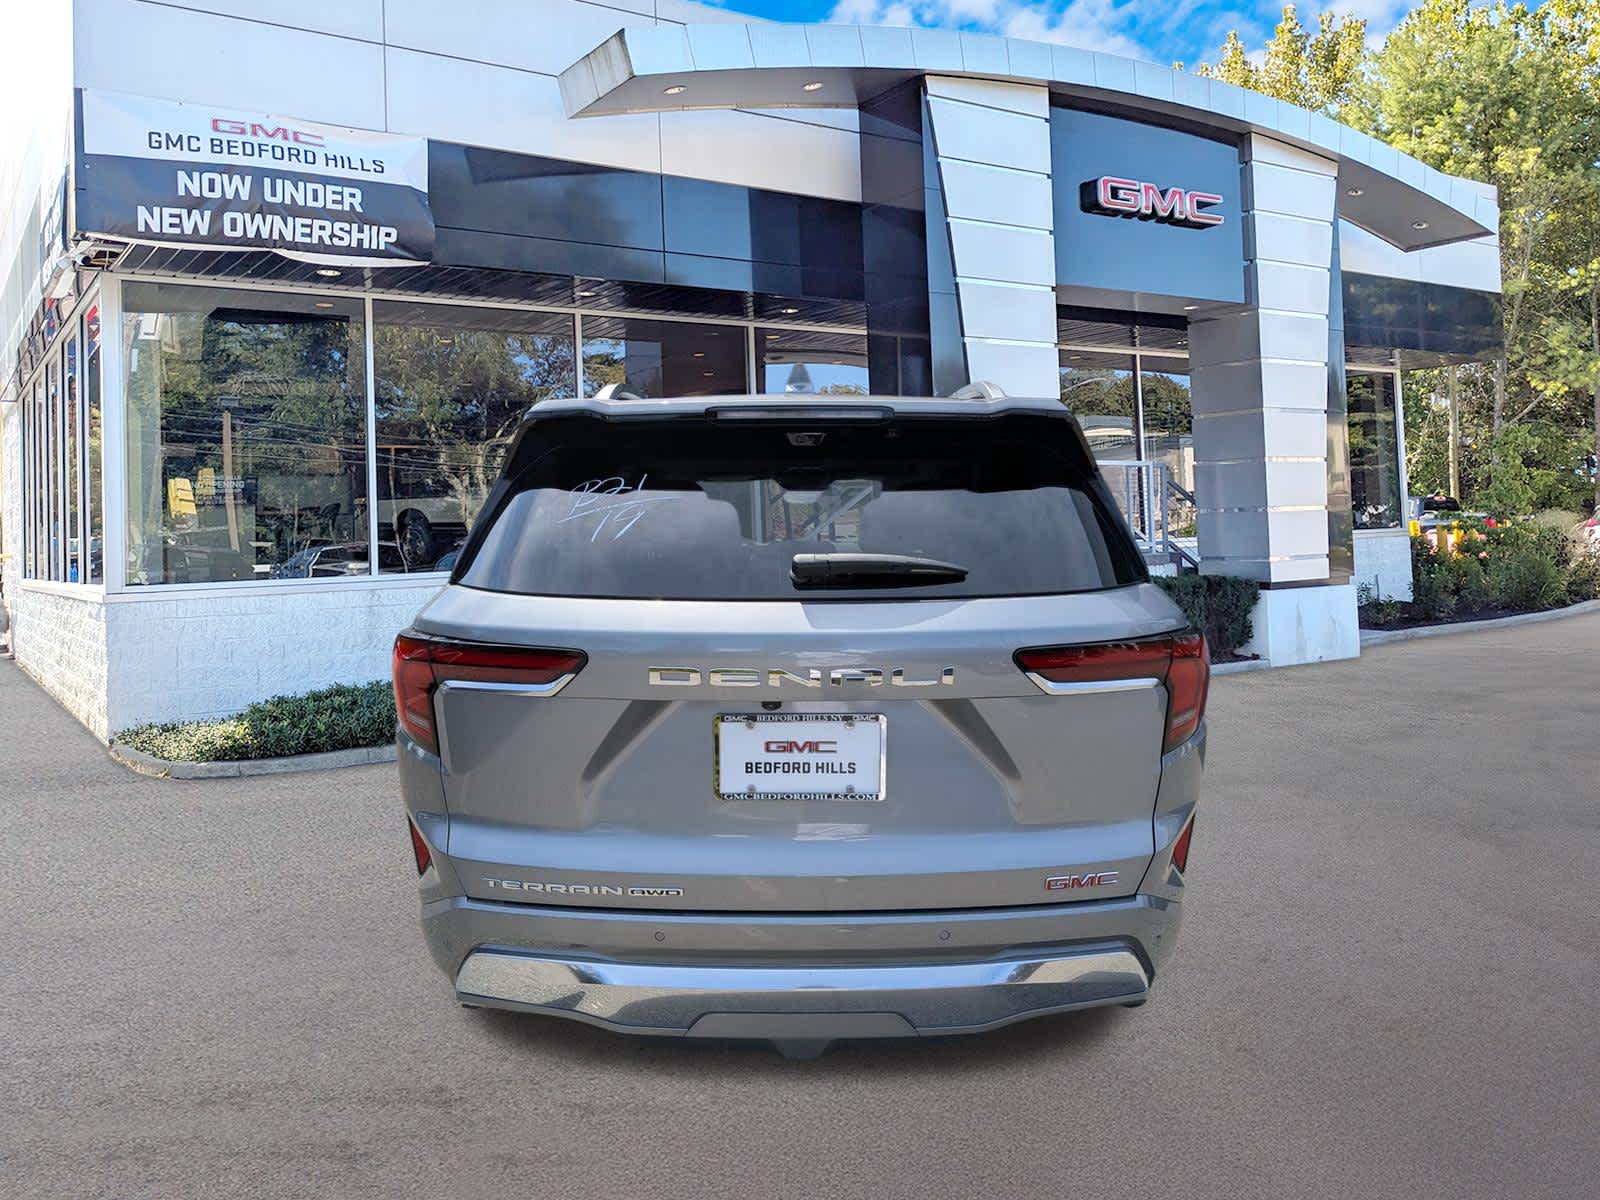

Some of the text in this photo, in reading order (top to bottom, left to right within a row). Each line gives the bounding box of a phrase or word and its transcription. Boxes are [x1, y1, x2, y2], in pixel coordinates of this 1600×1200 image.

[211, 118, 325, 148] GMC
[148, 131, 385, 174] GMC BEDFORD HILLS
[177, 170, 363, 213] NOW UNDER
[1098, 176, 1225, 225] GMC
[137, 206, 398, 250] NEW OWNERSHIP
[648, 666, 955, 687] DENALI
[756, 714, 800, 722] BEDFORD
[802, 714, 828, 722] HILLS
[764, 740, 837, 753] GMC
[744, 762, 857, 774] BEDFORD HILLS
[723, 792, 876, 800] GMCBEDFORDHILLS.COM
[481, 877, 684, 897] TERRAIN AWD
[1045, 871, 1119, 890] GMC
